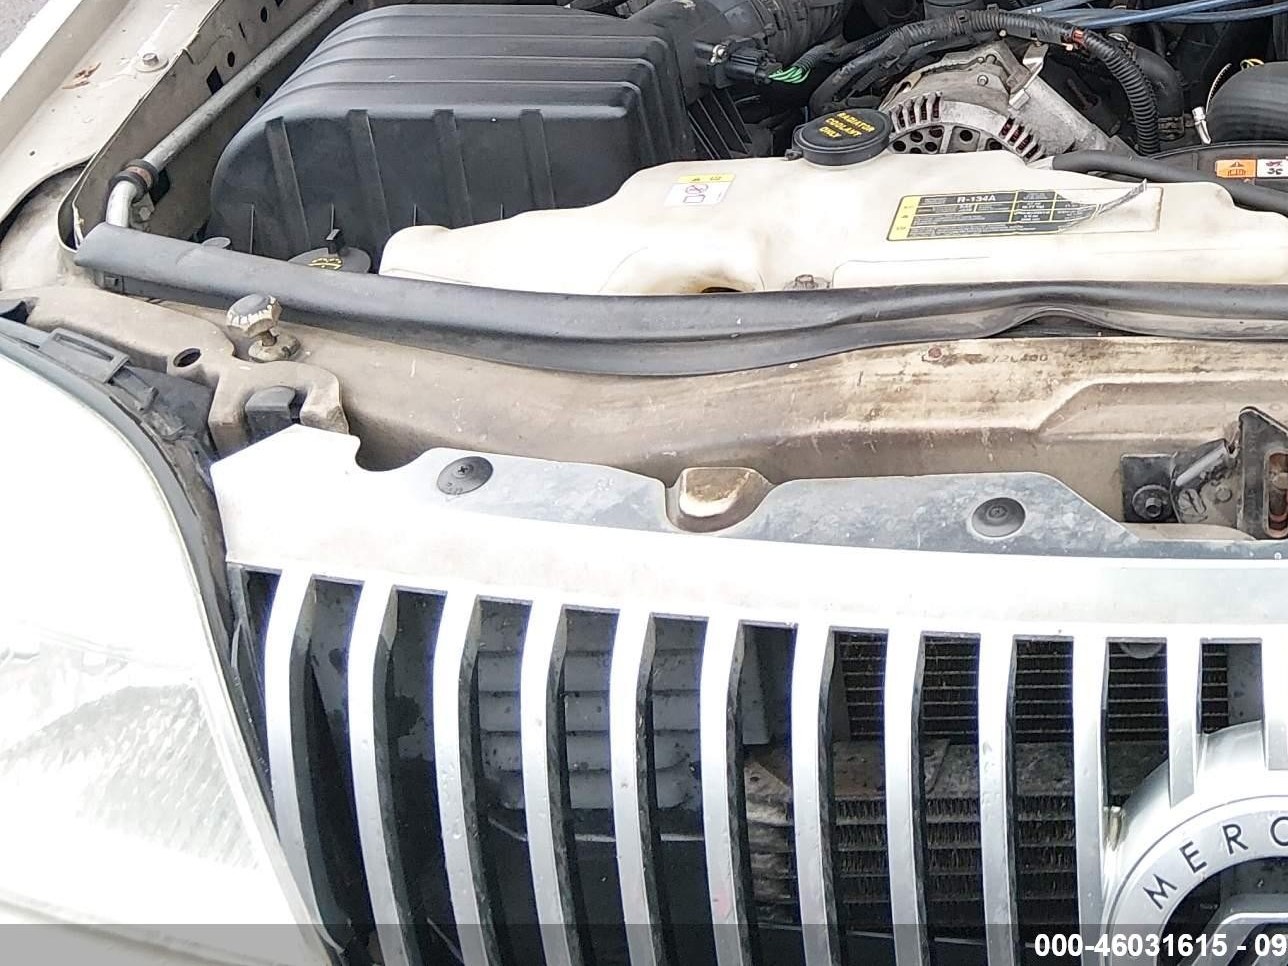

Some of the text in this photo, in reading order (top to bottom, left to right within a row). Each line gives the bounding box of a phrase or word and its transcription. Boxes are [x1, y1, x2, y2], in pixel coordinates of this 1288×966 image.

[825, 117, 862, 137] COOLANT
[836, 112, 875, 133] RADIATOR
[819, 126, 842, 138] ONLY
[956, 194, 997, 204] R-134A
